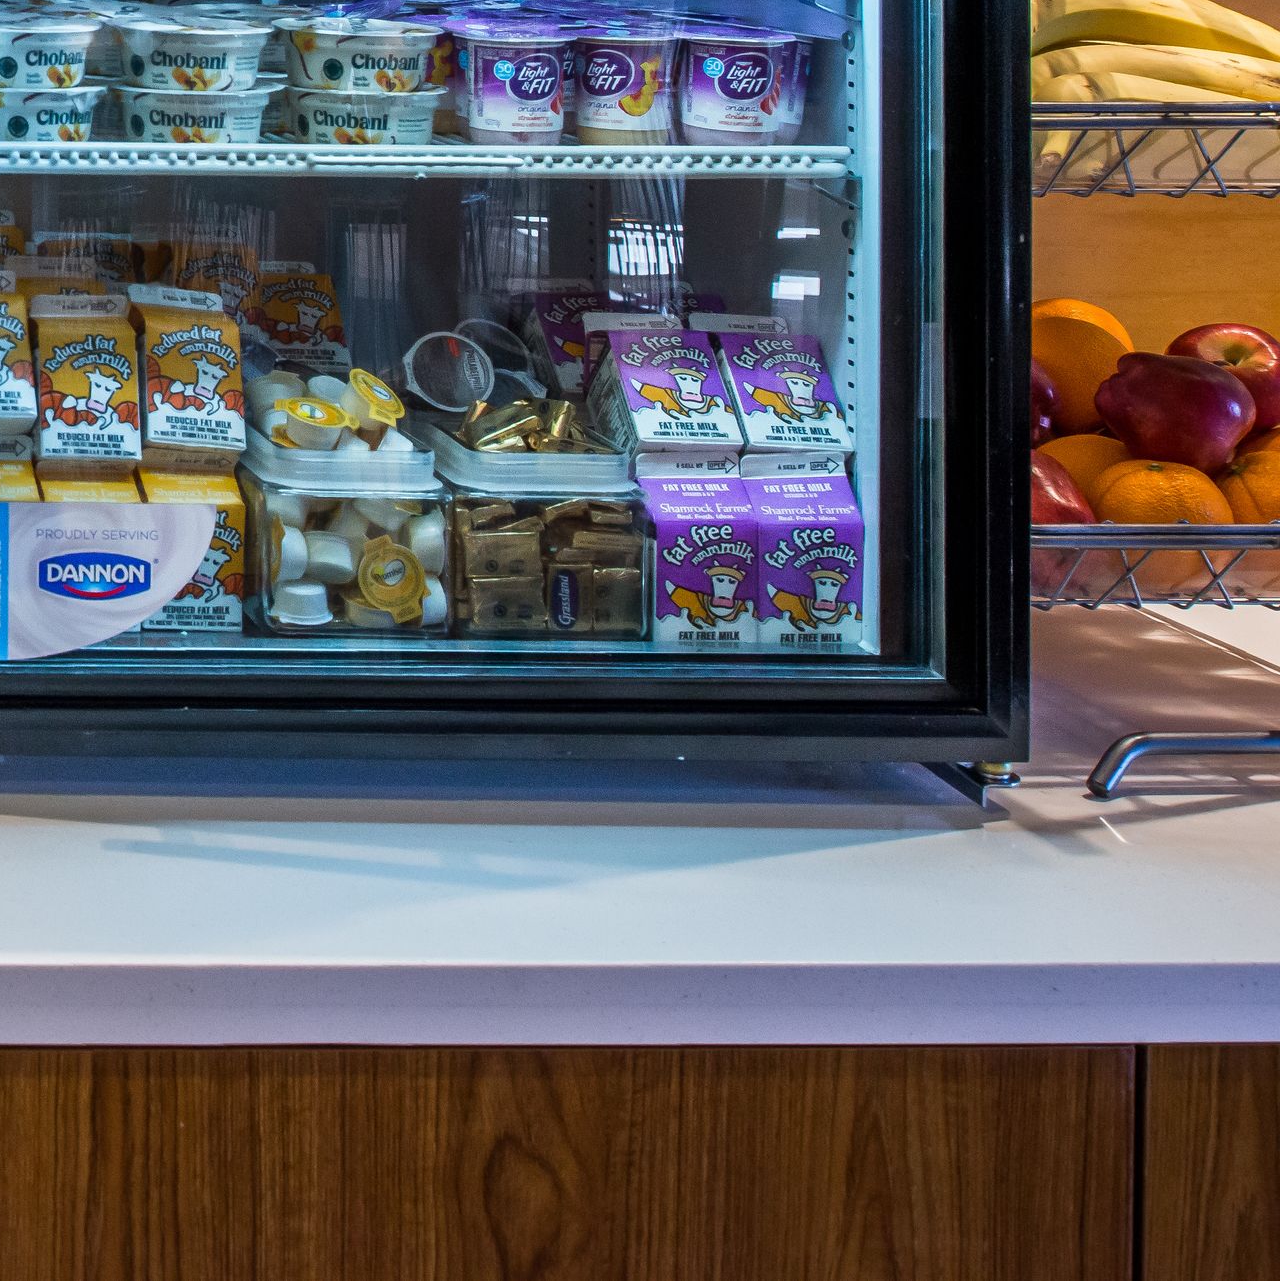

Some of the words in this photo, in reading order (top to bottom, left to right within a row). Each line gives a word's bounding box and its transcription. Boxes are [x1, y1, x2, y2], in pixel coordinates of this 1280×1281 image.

[150, 50, 228, 70] Chobani
[351, 53, 421, 71] Chobani
[706, 60, 721, 70] 50
[497, 63, 512, 73] 50
[518, 66, 550, 80] Light
[587, 63, 618, 77] Light
[727, 65, 762, 80] Light
[149, 110, 226, 129] Chobani
[313, 109, 390, 130] Chobani
[151, 325, 200, 358] reduced
[201, 325, 223, 343] fat
[44, 334, 93, 372] reduced
[95, 334, 117, 352] fat
[621, 344, 648, 367] fat
[642, 335, 682, 352] free
[733, 346, 760, 369] fat
[754, 338, 794, 356] free
[165, 416, 199, 427] REDUCED
[200, 418, 213, 427] FAT
[215, 420, 232, 429] MILK
[659, 422, 674, 431] FAT
[675, 422, 696, 431] FREE
[697, 423, 719, 432] MILK
[57, 432, 91, 442] REDUCED
[92, 433, 105, 442] FAT
[107, 434, 125, 443] MILK
[771, 425, 786, 435] FAT
[787, 426, 808, 435] FREE
[809, 426, 831, 436] MILK
[662, 484, 679, 492] FAT
[681, 484, 703, 492] FREE
[705, 483, 730, 492] MILK
[763, 484, 780, 493] FAT
[782, 483, 806, 493] FREE
[808, 483, 833, 492] MILK
[660, 503, 713, 514] Shamrock
[761, 505, 816, 516] Shamrock
[36, 528, 97, 541] PROUDLY
[102, 529, 159, 541] SERVING
[662, 536, 693, 566] fat
[691, 524, 733, 544] free
[765, 540, 796, 569] fat
[792, 527, 835, 547] free
[46, 563, 146, 584] DANNON
[558, 574, 576, 626] Grassland
[162, 605, 195, 615] REDUCED
[197, 605, 211, 615] FAT
[212, 605, 230, 615] MILK
[679, 631, 694, 641] FAT
[696, 631, 716, 641] FREE
[718, 631, 740, 641] MILK
[780, 633, 796, 643] FAT
[798, 633, 818, 643] FREE
[820, 633, 841, 643] MILK
